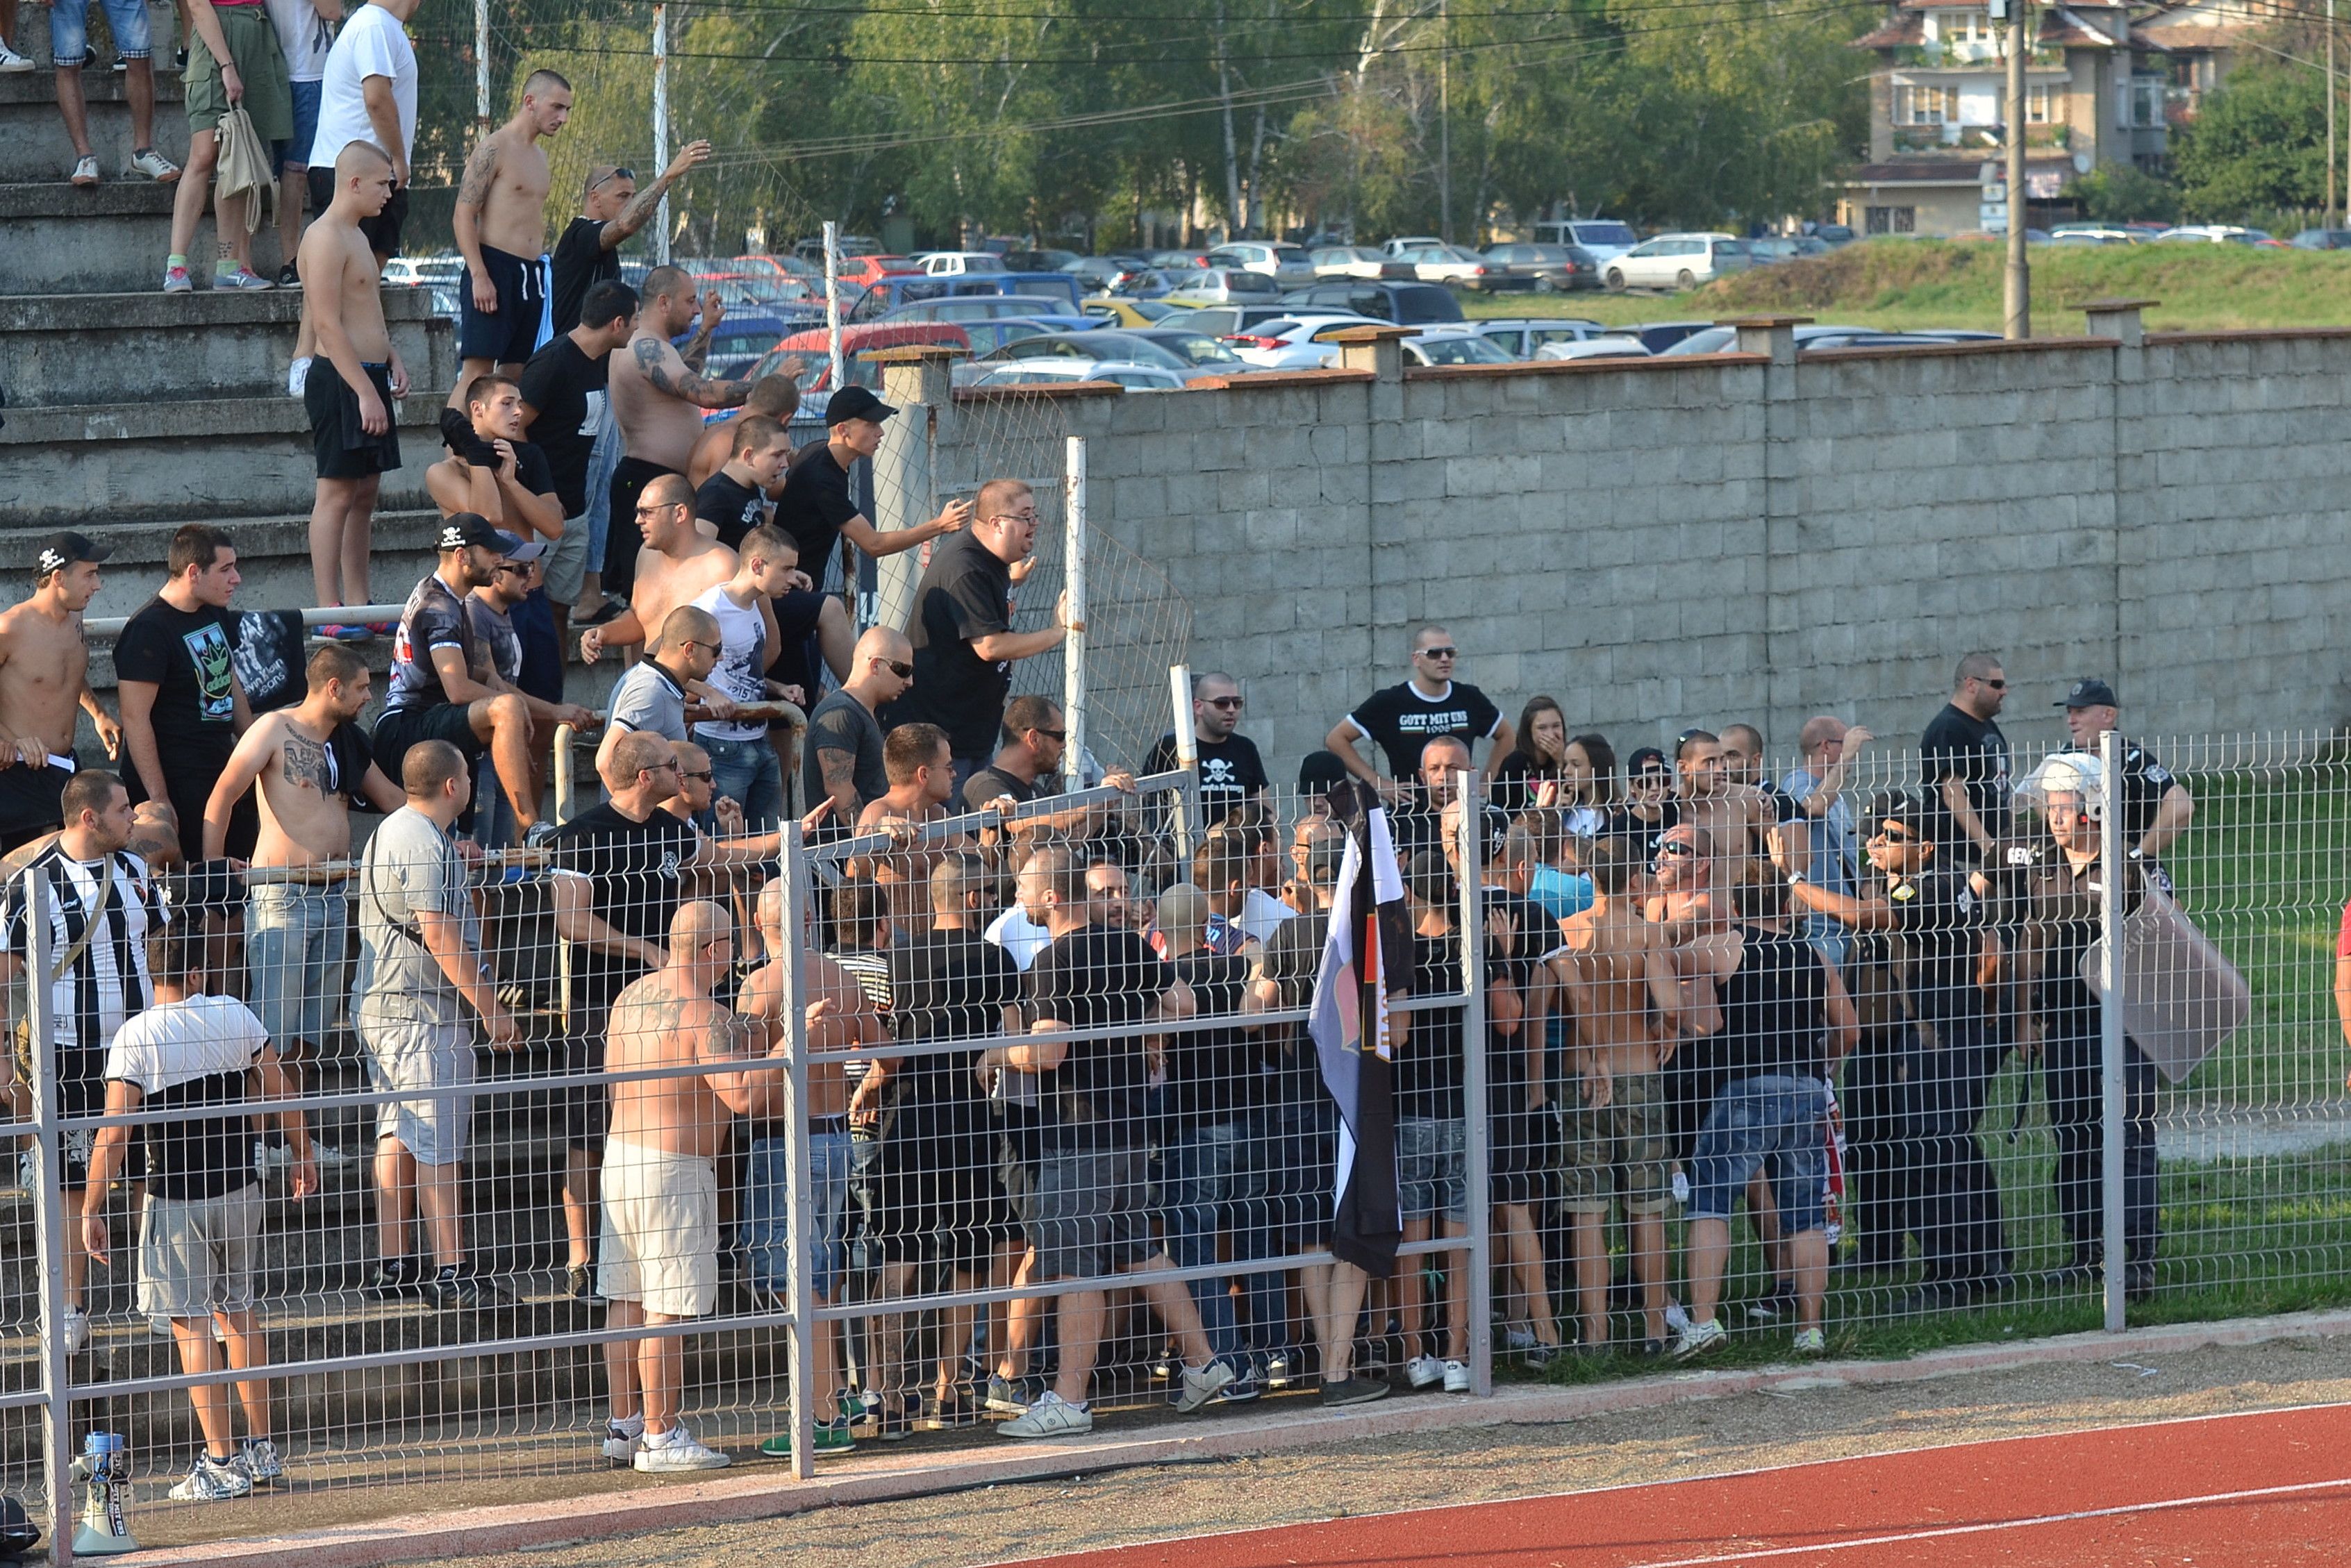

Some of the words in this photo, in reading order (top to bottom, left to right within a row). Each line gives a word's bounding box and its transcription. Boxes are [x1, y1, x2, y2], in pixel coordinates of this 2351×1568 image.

[1399, 713, 1428, 726] GOTT
[1429, 712, 1449, 725] MIT
[1450, 710, 1468, 723] UNS
